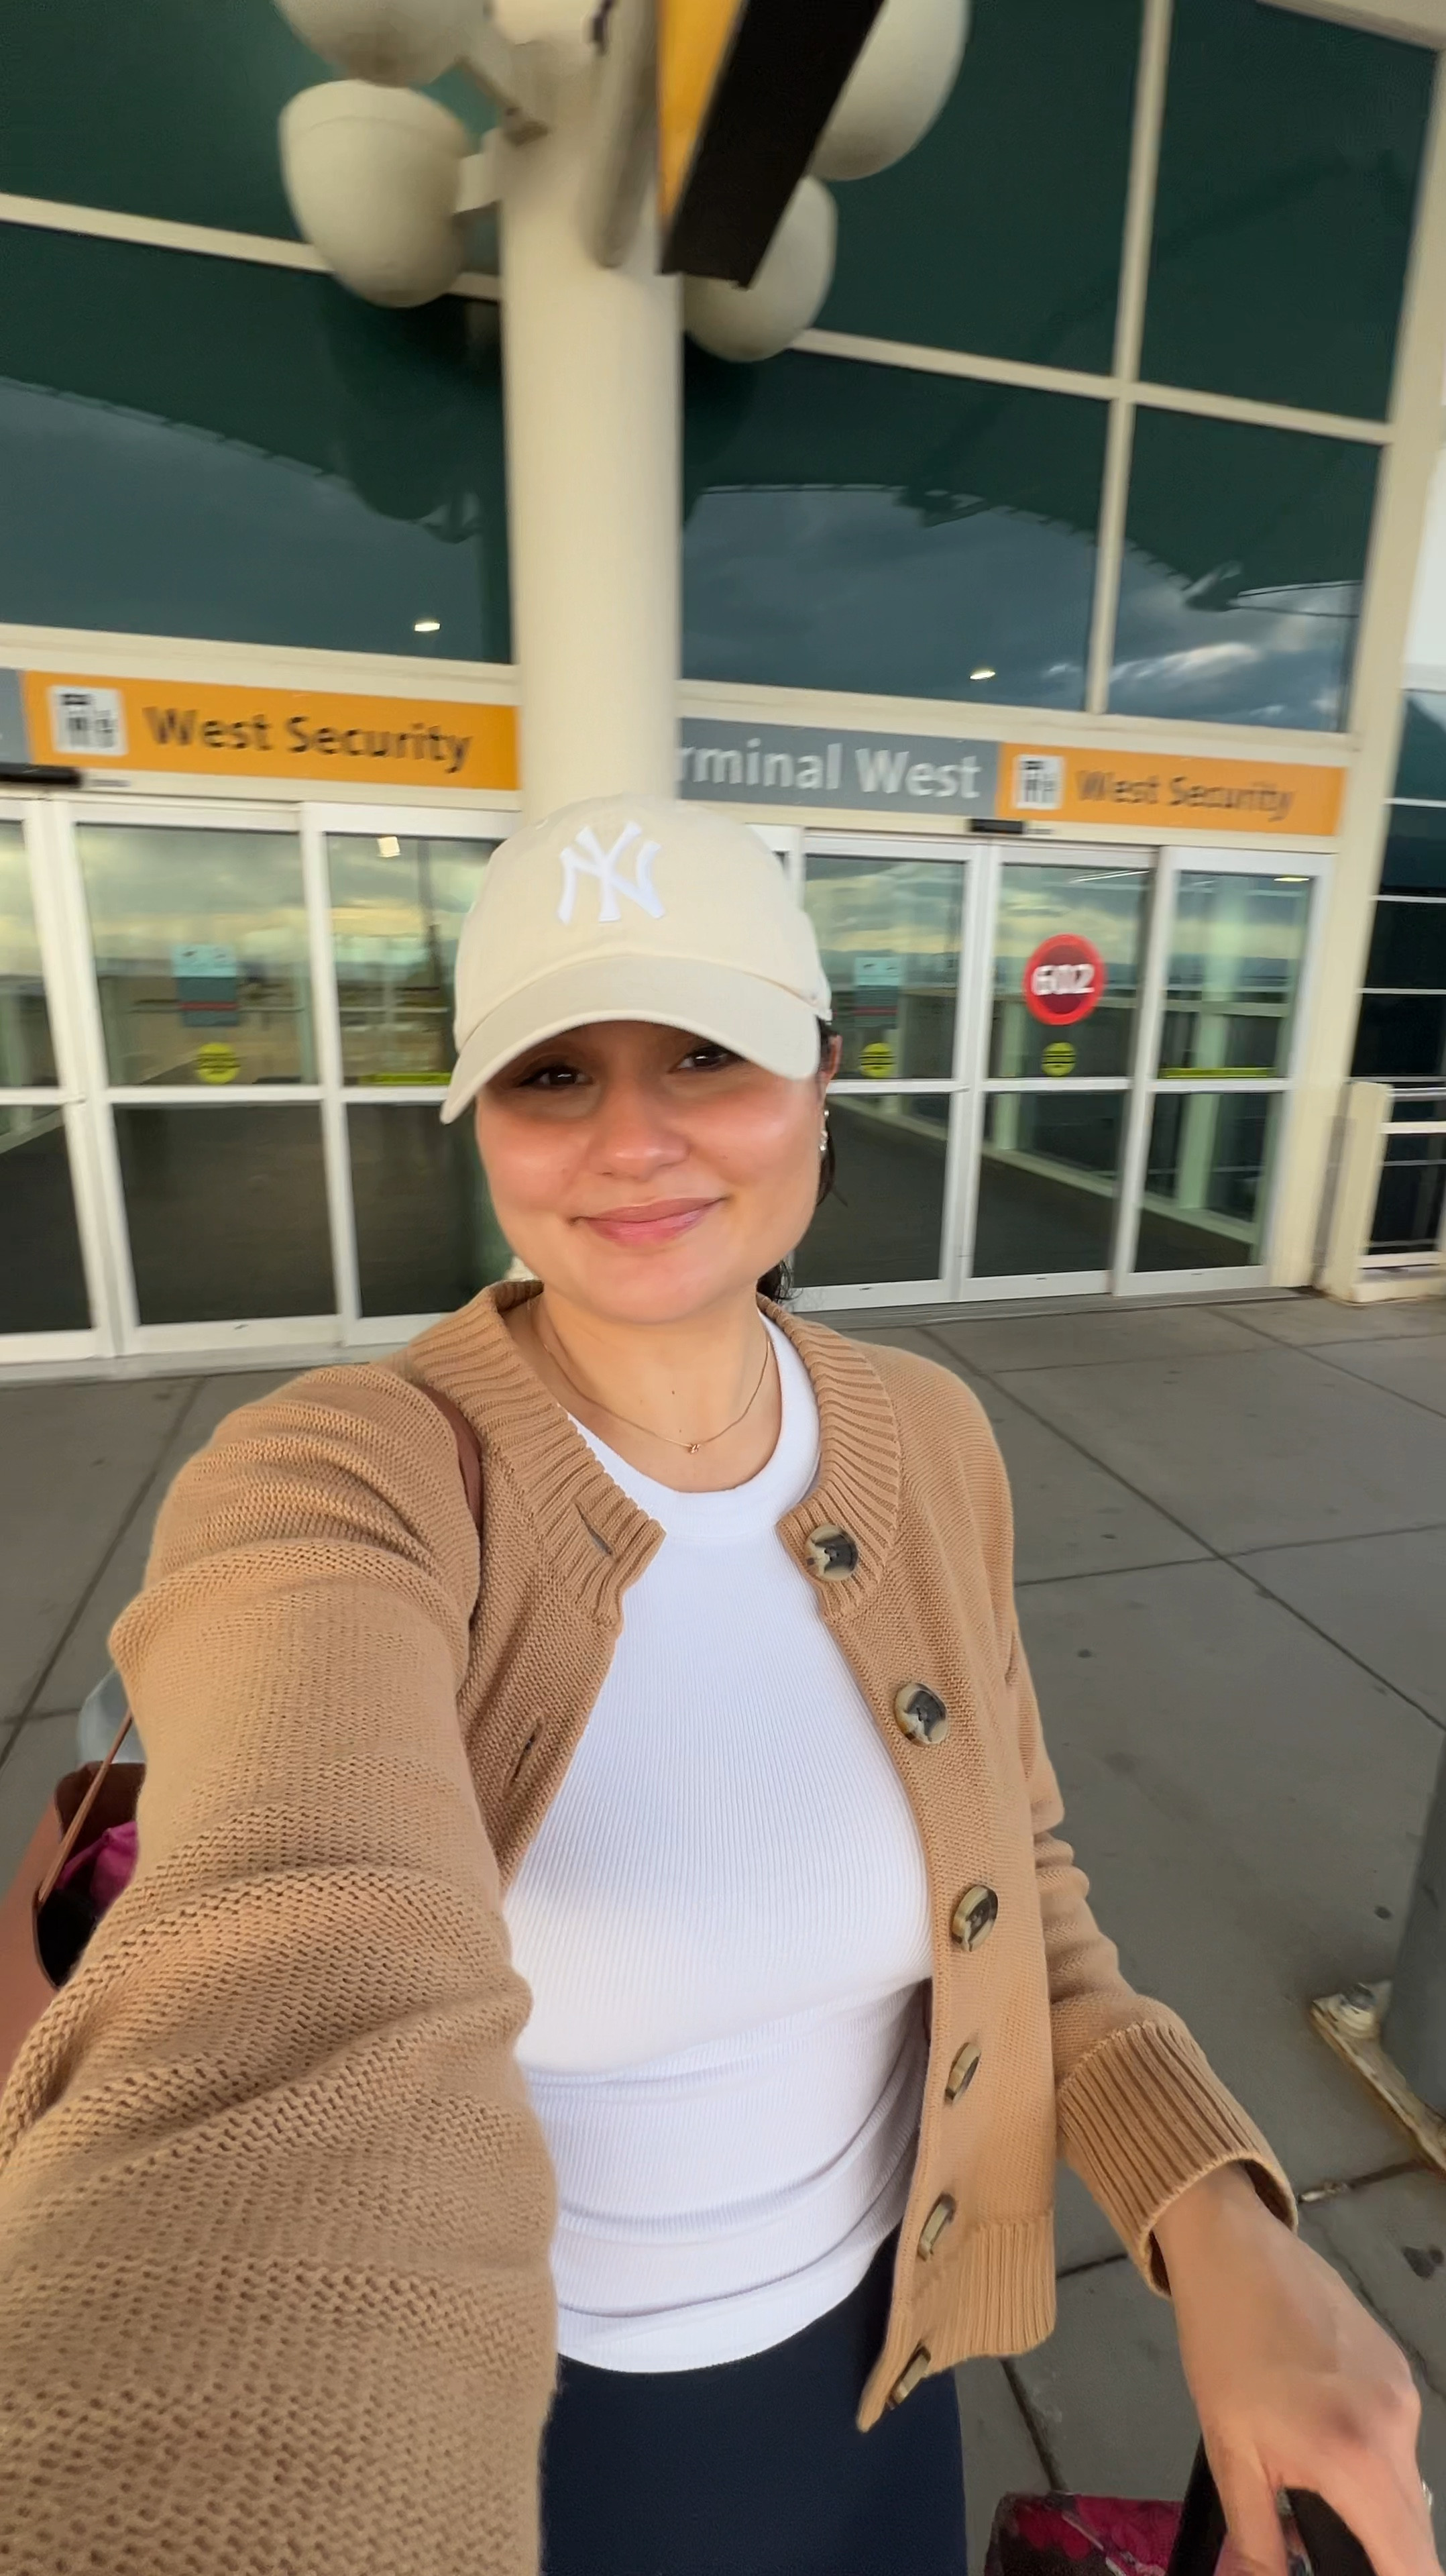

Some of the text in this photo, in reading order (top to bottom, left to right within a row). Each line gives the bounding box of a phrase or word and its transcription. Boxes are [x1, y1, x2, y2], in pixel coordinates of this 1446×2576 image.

[142, 706, 474, 773] West Security
[854, 748, 982, 799] West
[1075, 769, 1296, 822] West Security
[557, 821, 665, 924] NY
